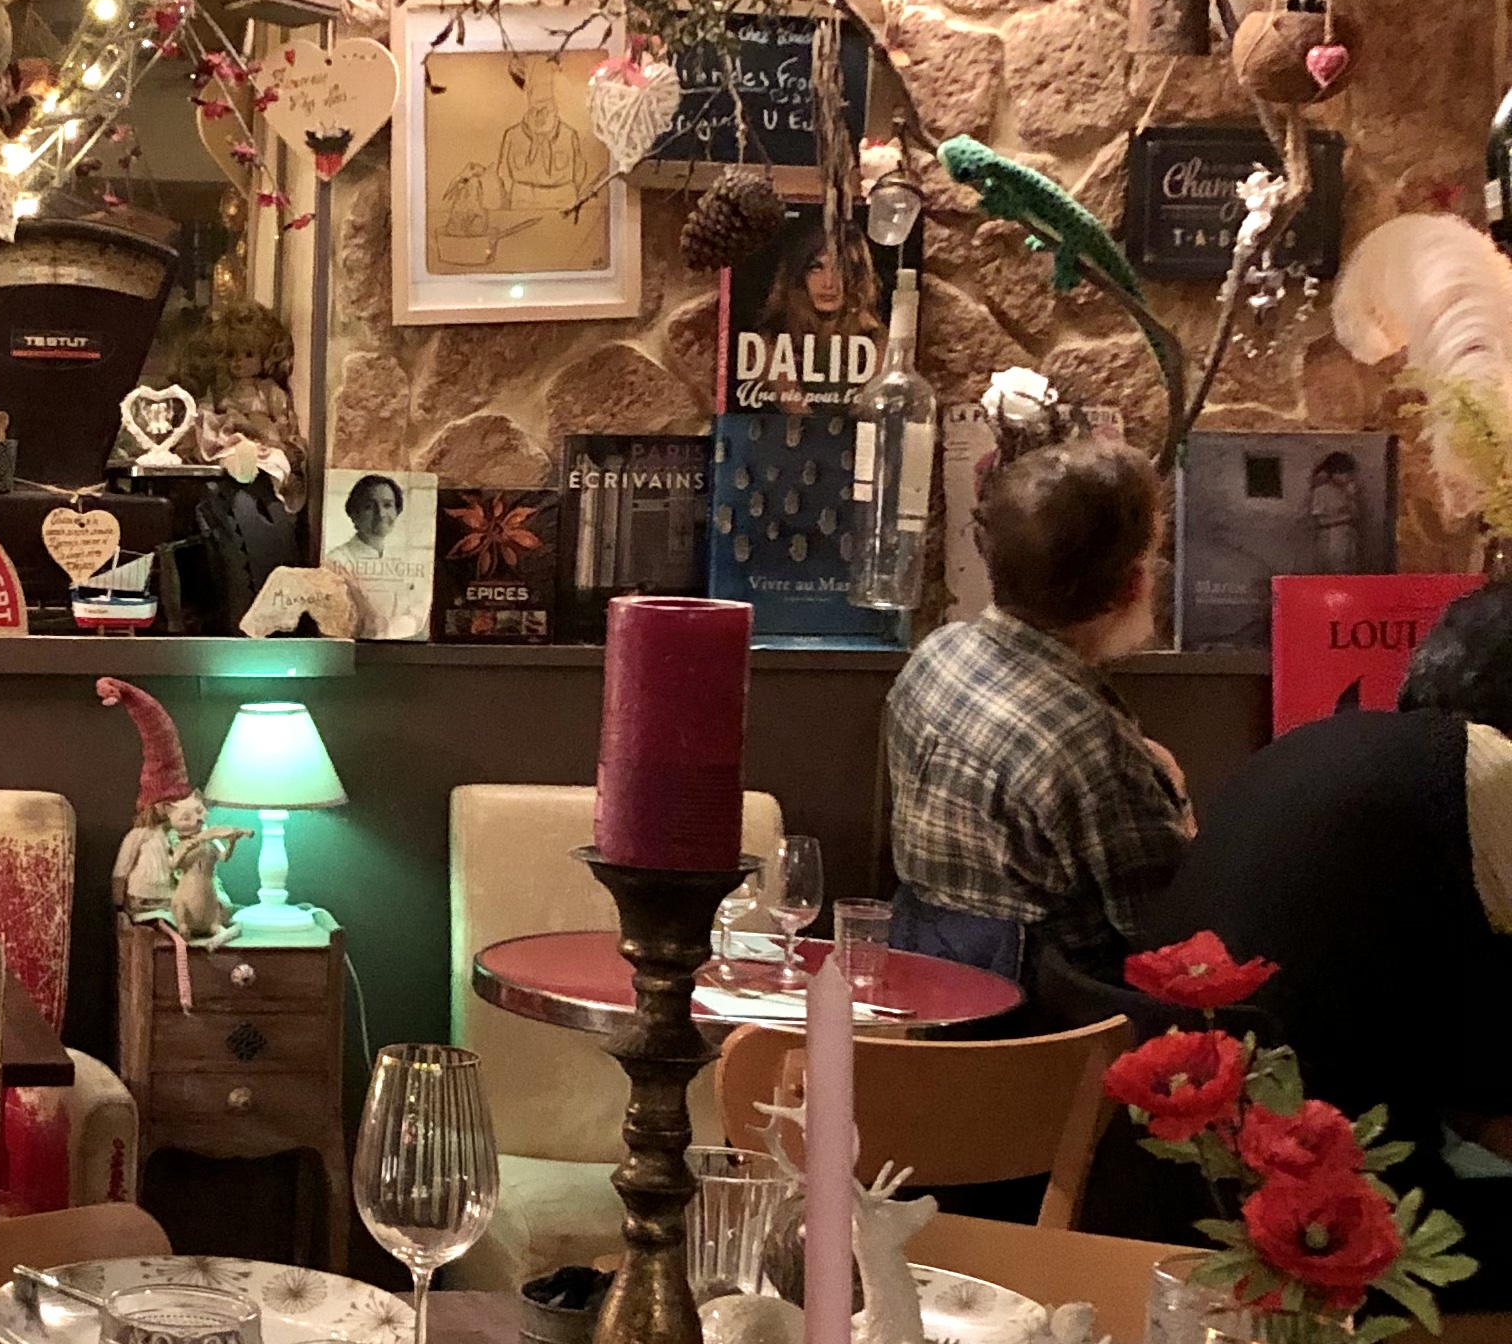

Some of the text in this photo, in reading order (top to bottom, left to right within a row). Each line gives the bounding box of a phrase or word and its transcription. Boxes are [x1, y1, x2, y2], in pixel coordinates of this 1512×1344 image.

[23, 336, 89, 347] TESTUT
[736, 331, 878, 384] DALID
[1328, 619, 1418, 649] LOUI
